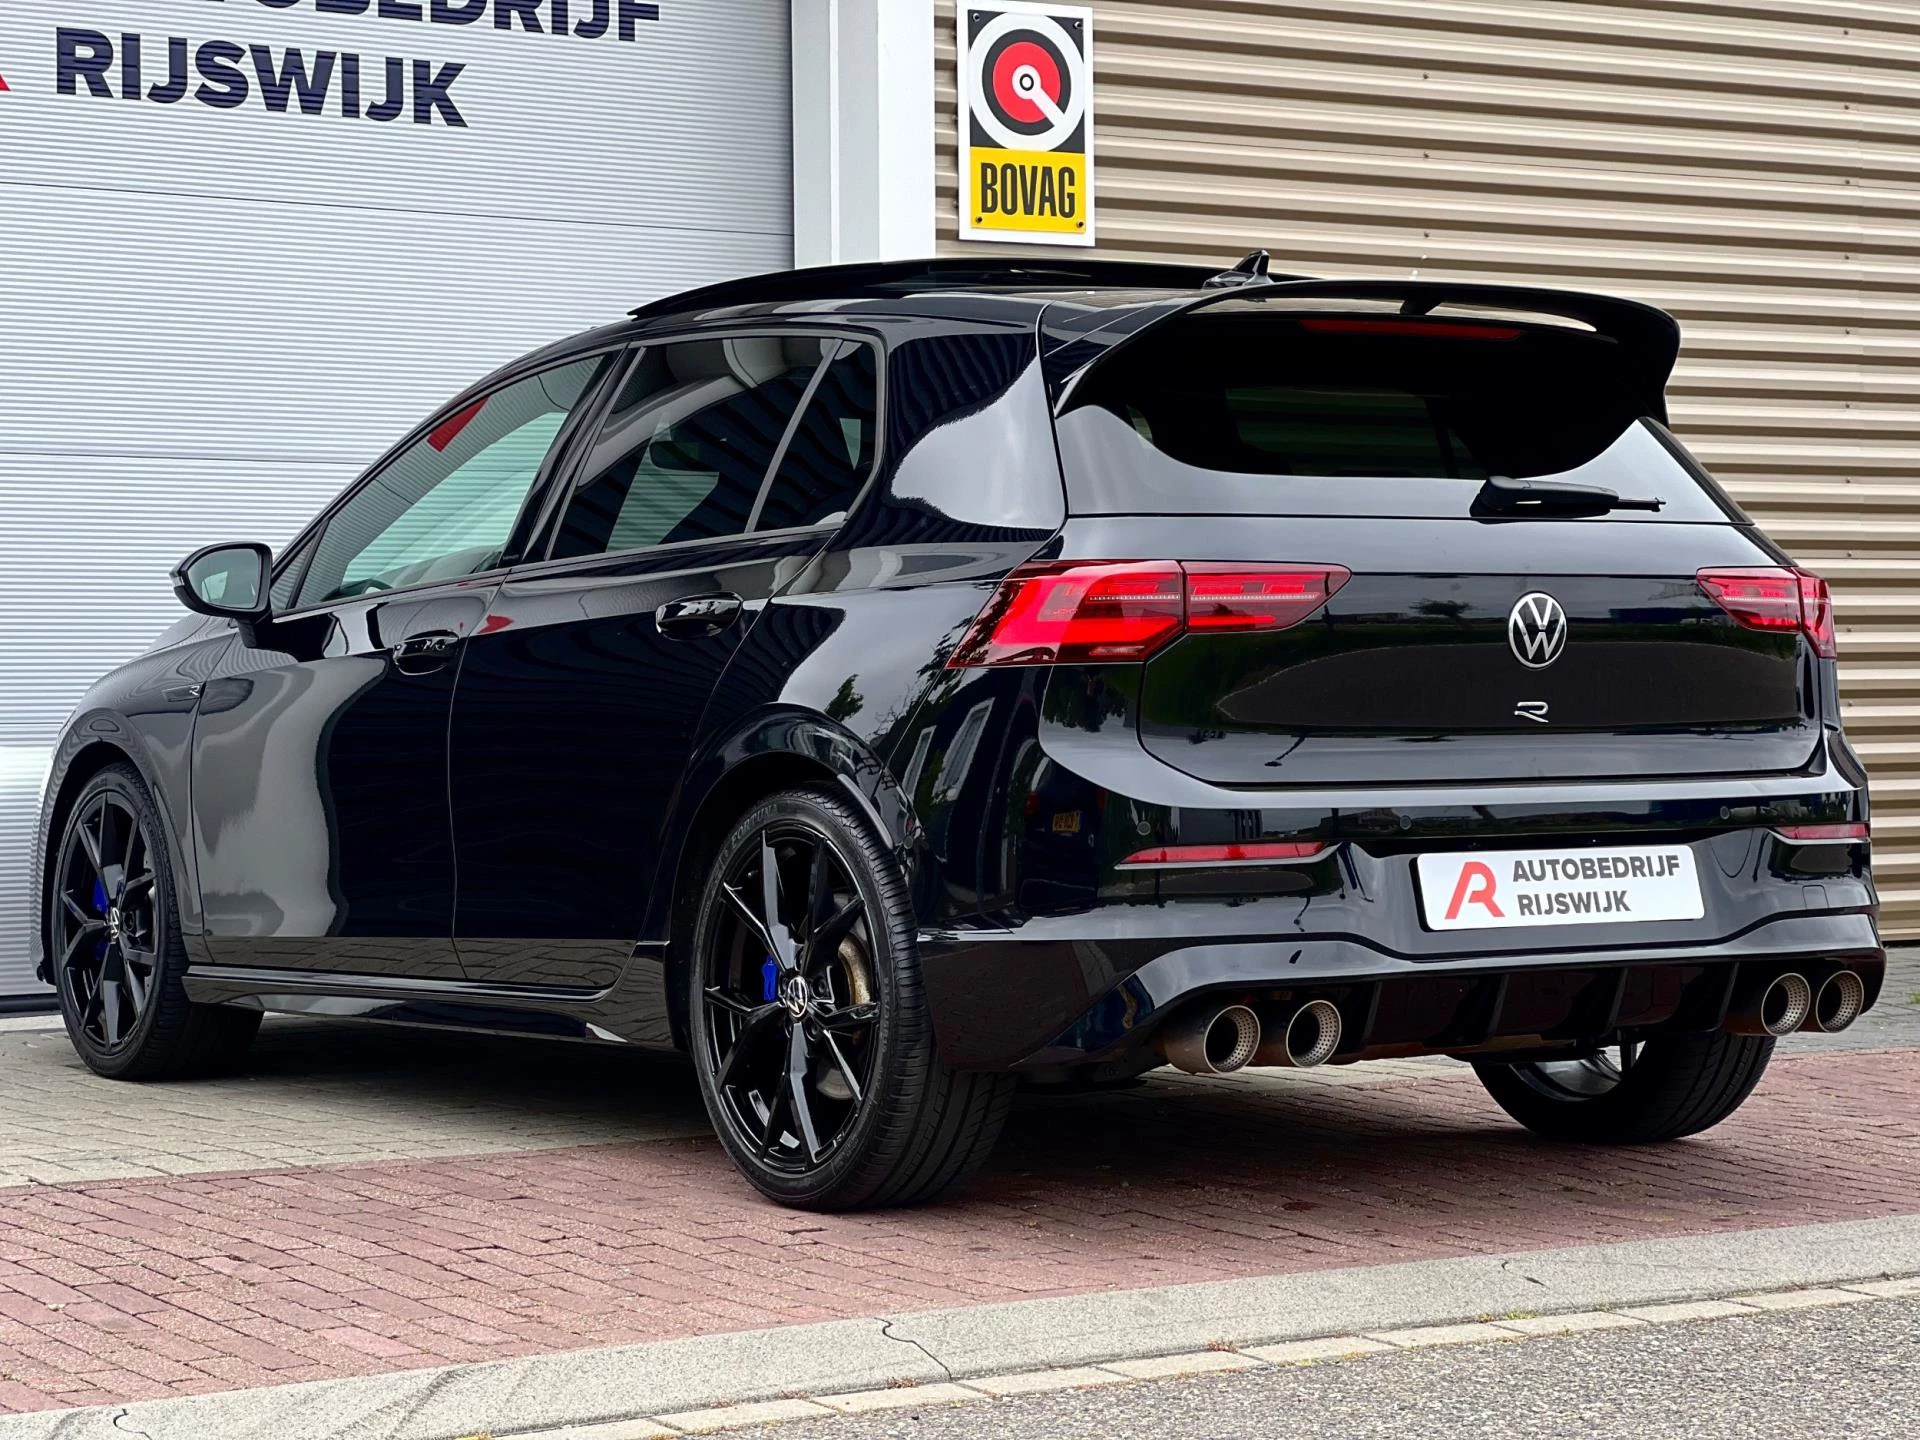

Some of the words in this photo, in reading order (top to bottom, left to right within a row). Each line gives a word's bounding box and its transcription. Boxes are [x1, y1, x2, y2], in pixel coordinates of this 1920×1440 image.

[56, 26, 468, 127] RIJSWIJK
[980, 162, 1076, 219] BOVAG
[1513, 854, 1681, 882] AUTOBEDRIJF
[1517, 890, 1632, 916] RIJSWIJK
